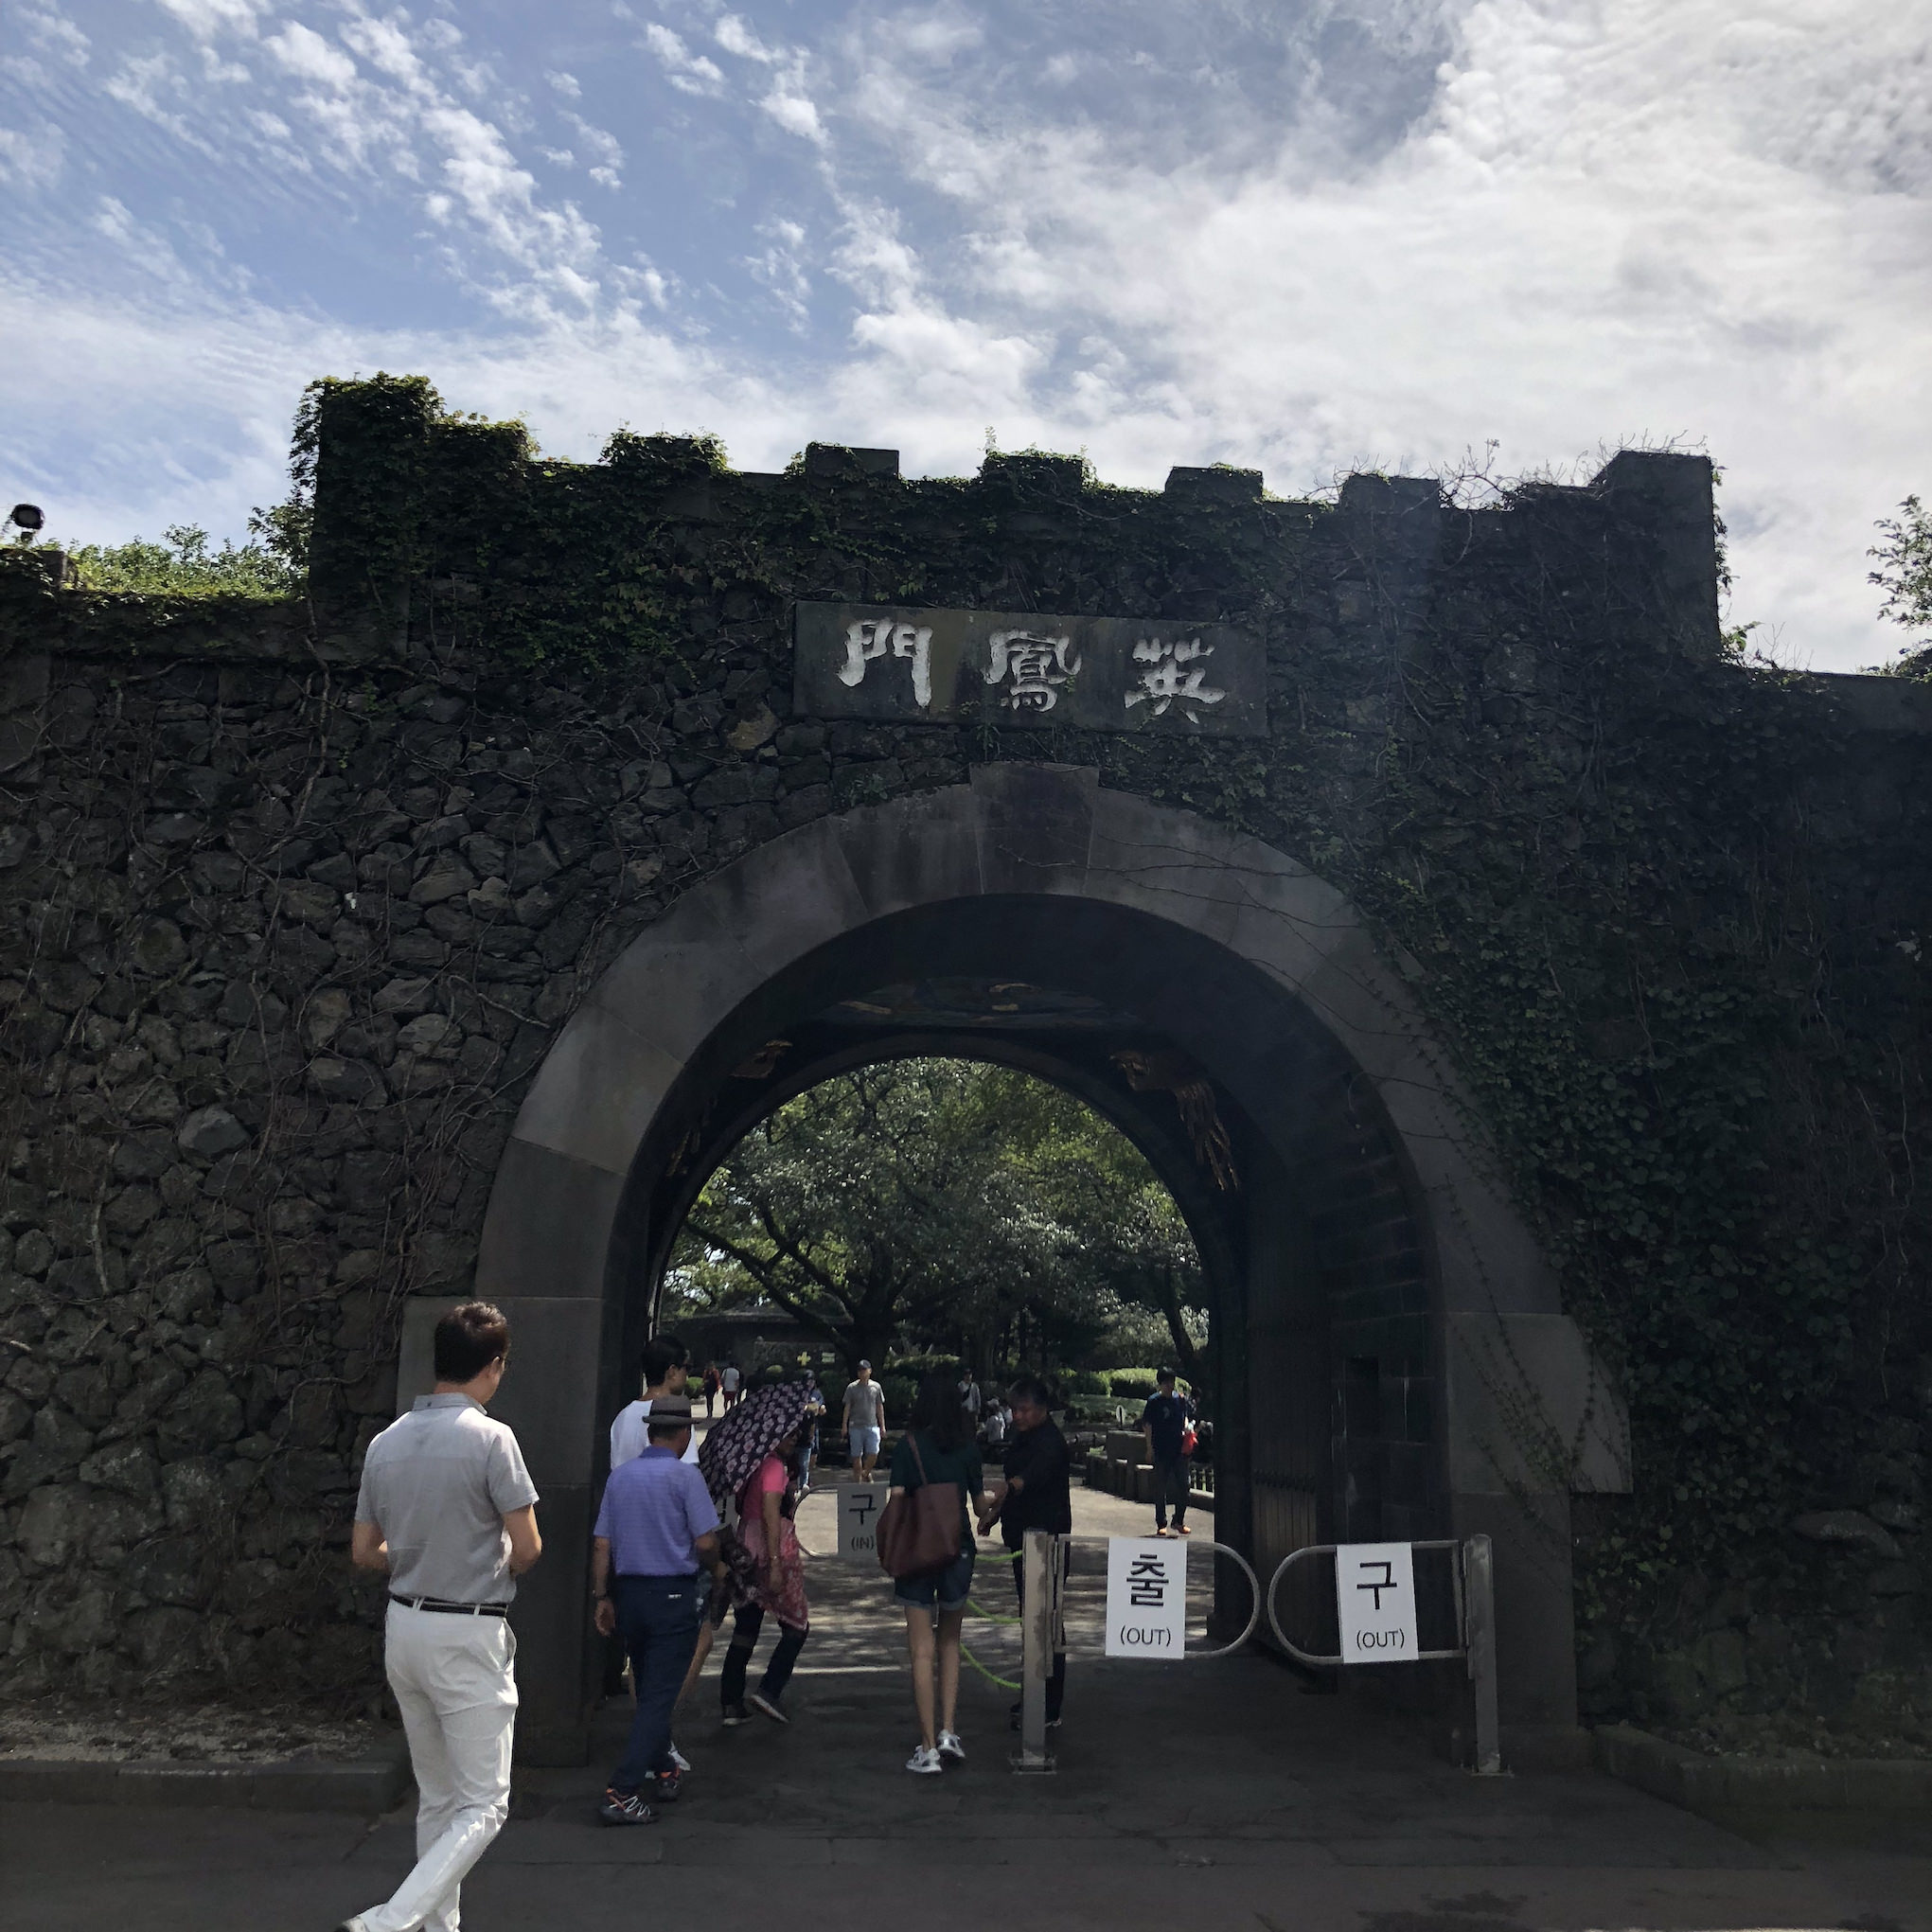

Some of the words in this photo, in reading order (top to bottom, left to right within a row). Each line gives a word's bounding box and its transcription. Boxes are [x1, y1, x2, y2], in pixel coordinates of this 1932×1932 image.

[849, 1494, 877, 1525] 구
[851, 1535, 875, 1551] (IN)
[1126, 1553, 1170, 1607] 출
[1356, 1561, 1398, 1610] 구
[1120, 1624, 1172, 1648] (OUT)
[1356, 1627, 1406, 1652] (OUT)
